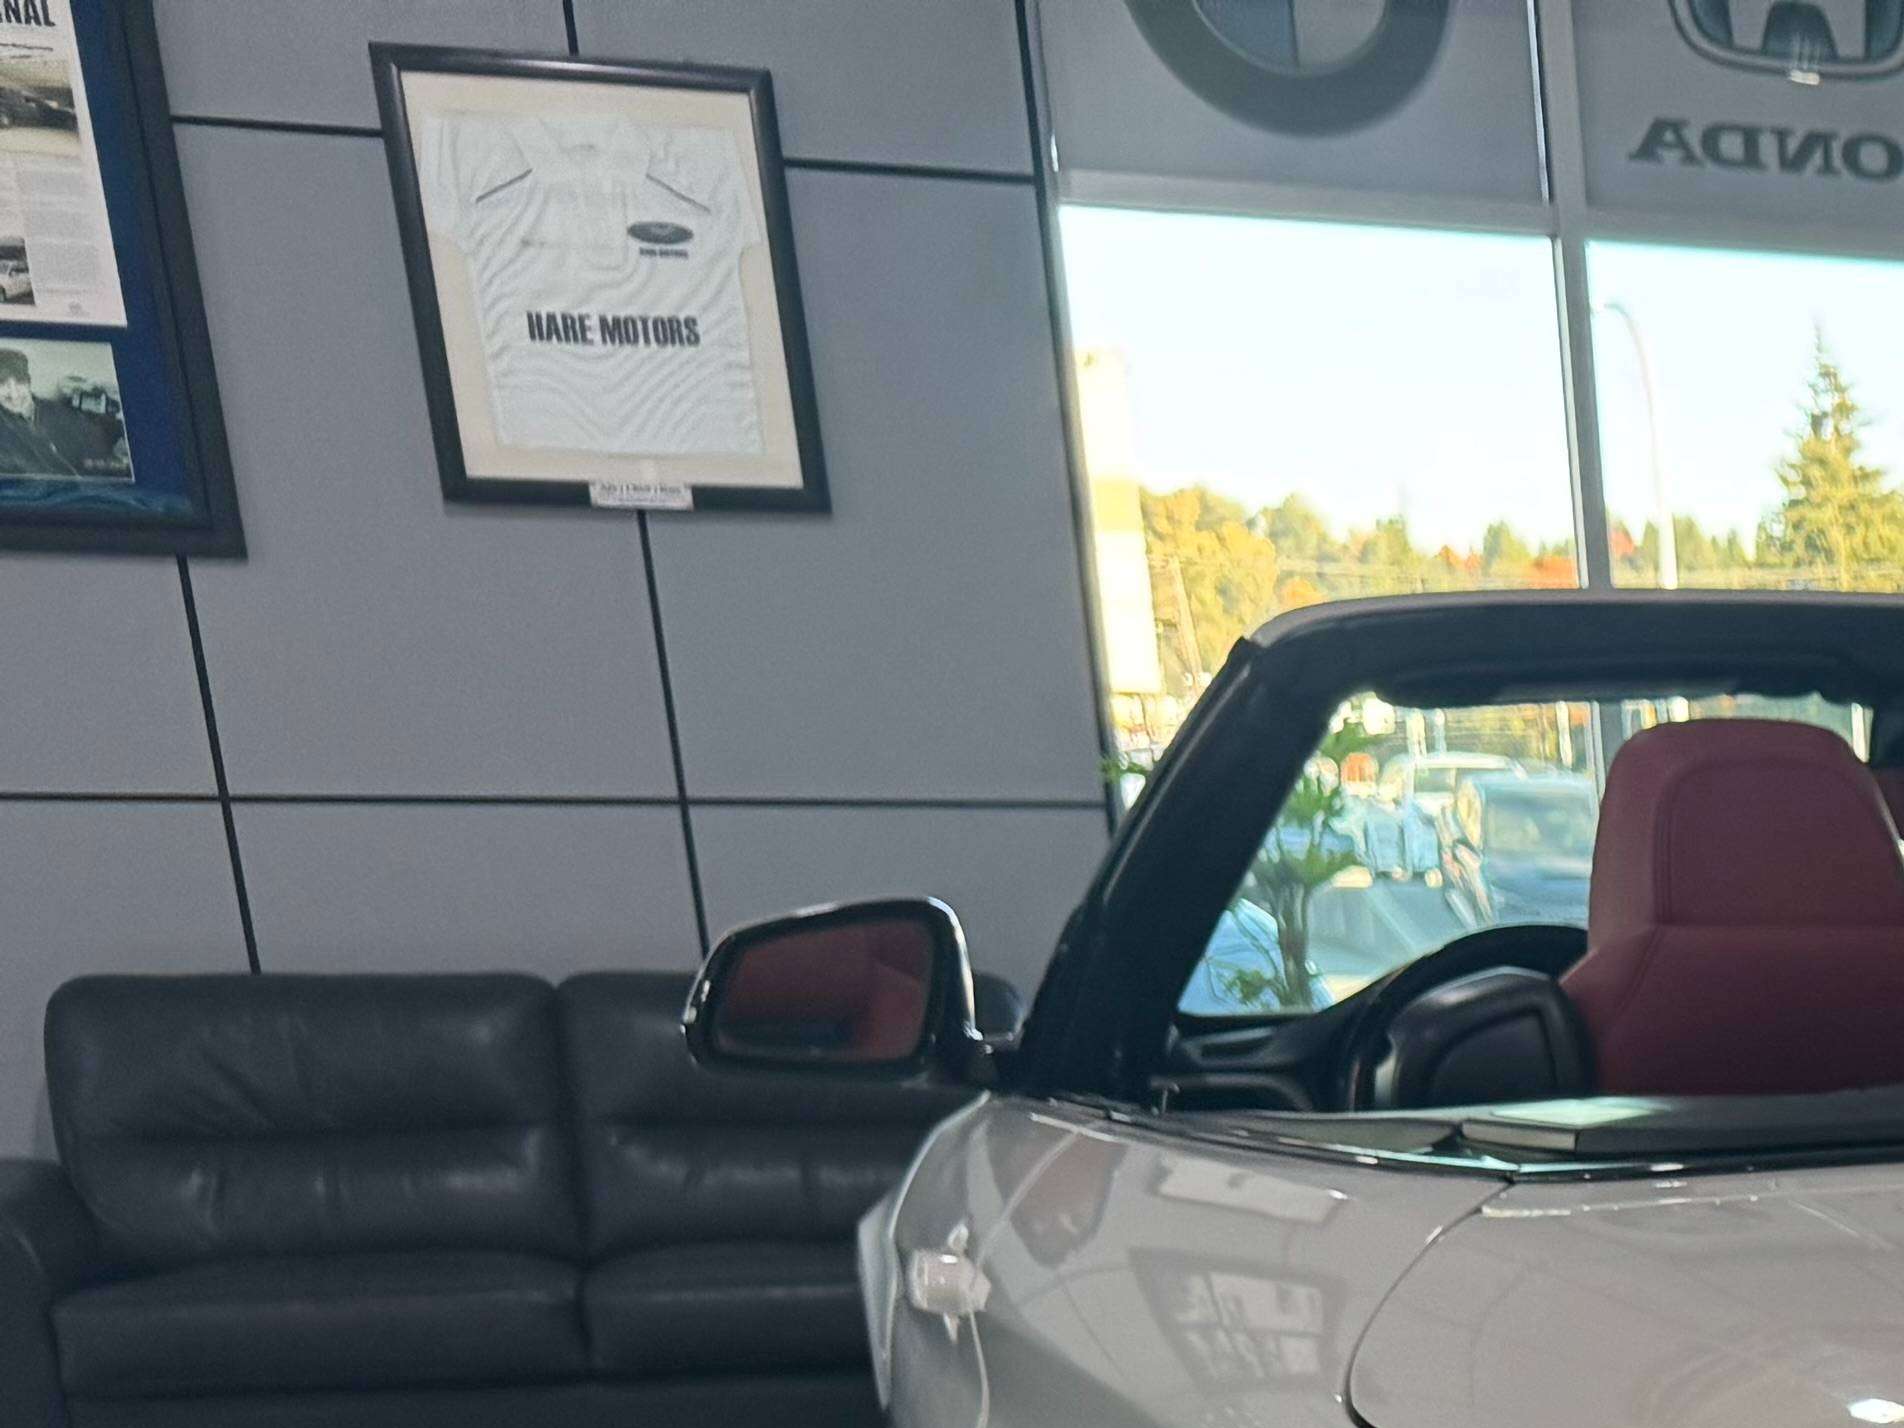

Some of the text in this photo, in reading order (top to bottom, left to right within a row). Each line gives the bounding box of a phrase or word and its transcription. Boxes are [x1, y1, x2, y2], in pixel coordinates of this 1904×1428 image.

[0, 0, 55, 27] NAL
[527, 311, 700, 348] HARE MOTORS
